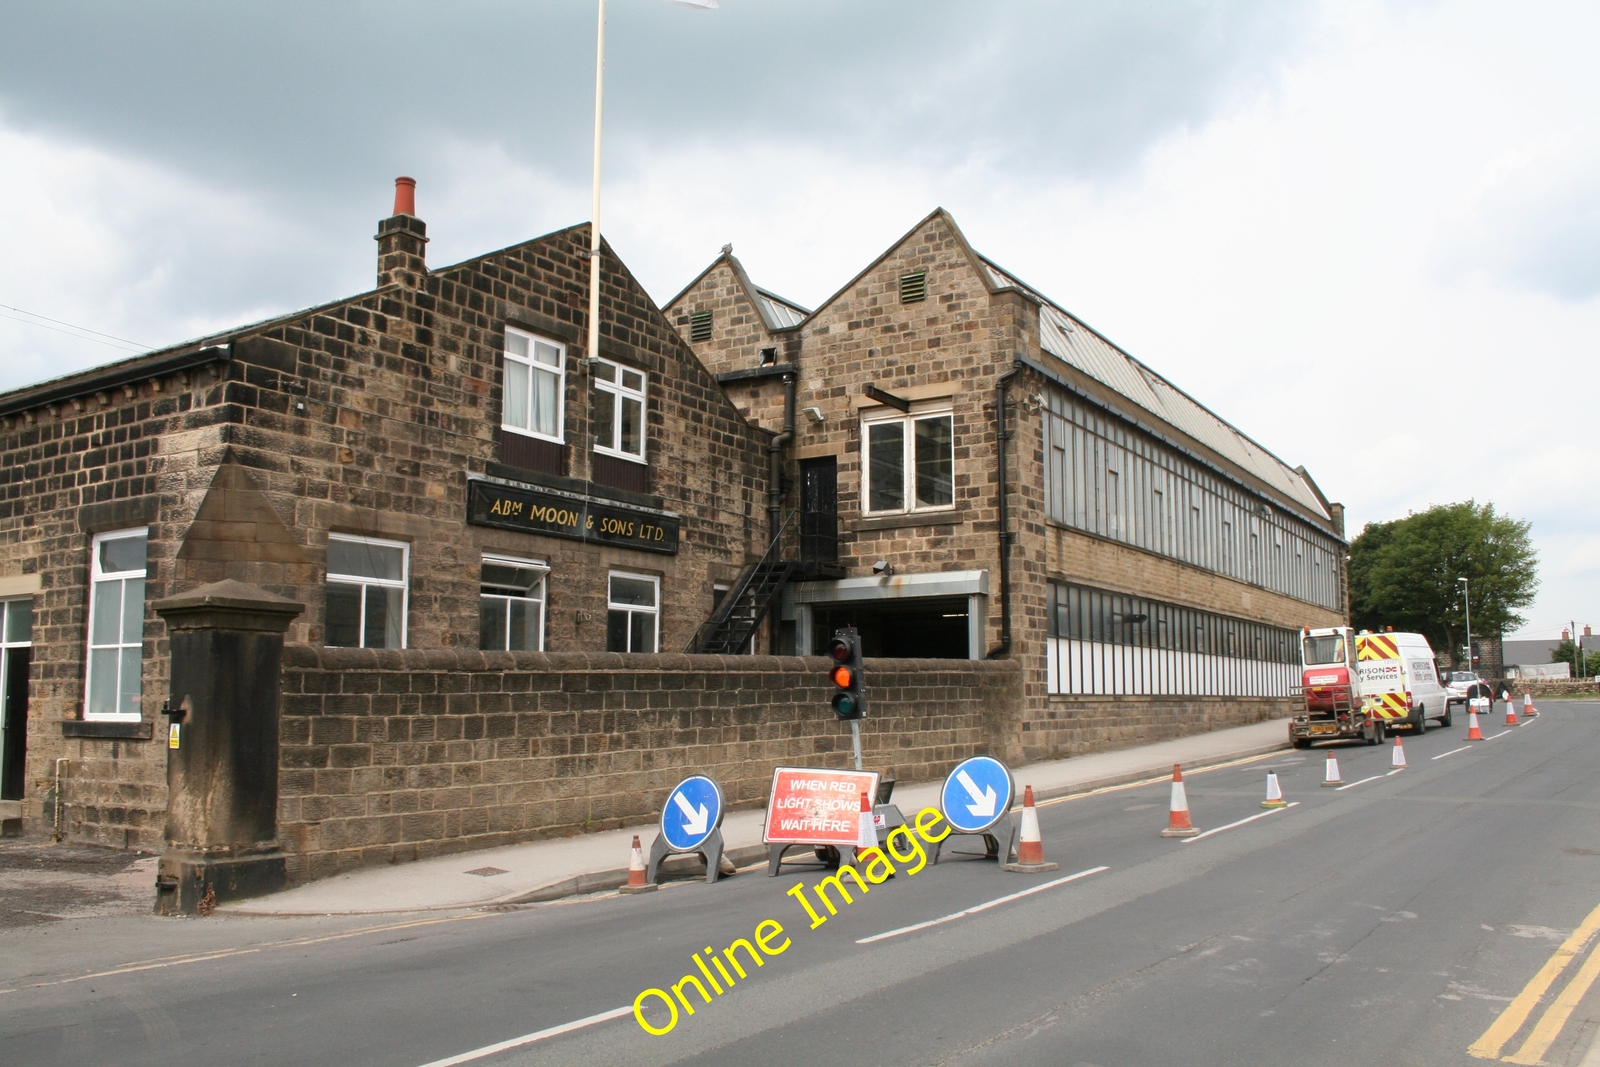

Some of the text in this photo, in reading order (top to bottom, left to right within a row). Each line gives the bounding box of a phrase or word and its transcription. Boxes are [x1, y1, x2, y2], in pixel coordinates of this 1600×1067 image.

[530, 504, 579, 527] MOON
[585, 514, 594, 530] &
[600, 517, 634, 536] SONS
[639, 524, 665, 542] LTD.
[1366, 673, 1398, 681] Services
[790, 779, 857, 793] WHEN RED
[776, 798, 861, 812] LIGHT SHOWS
[780, 819, 850, 833] WAIT HERE
